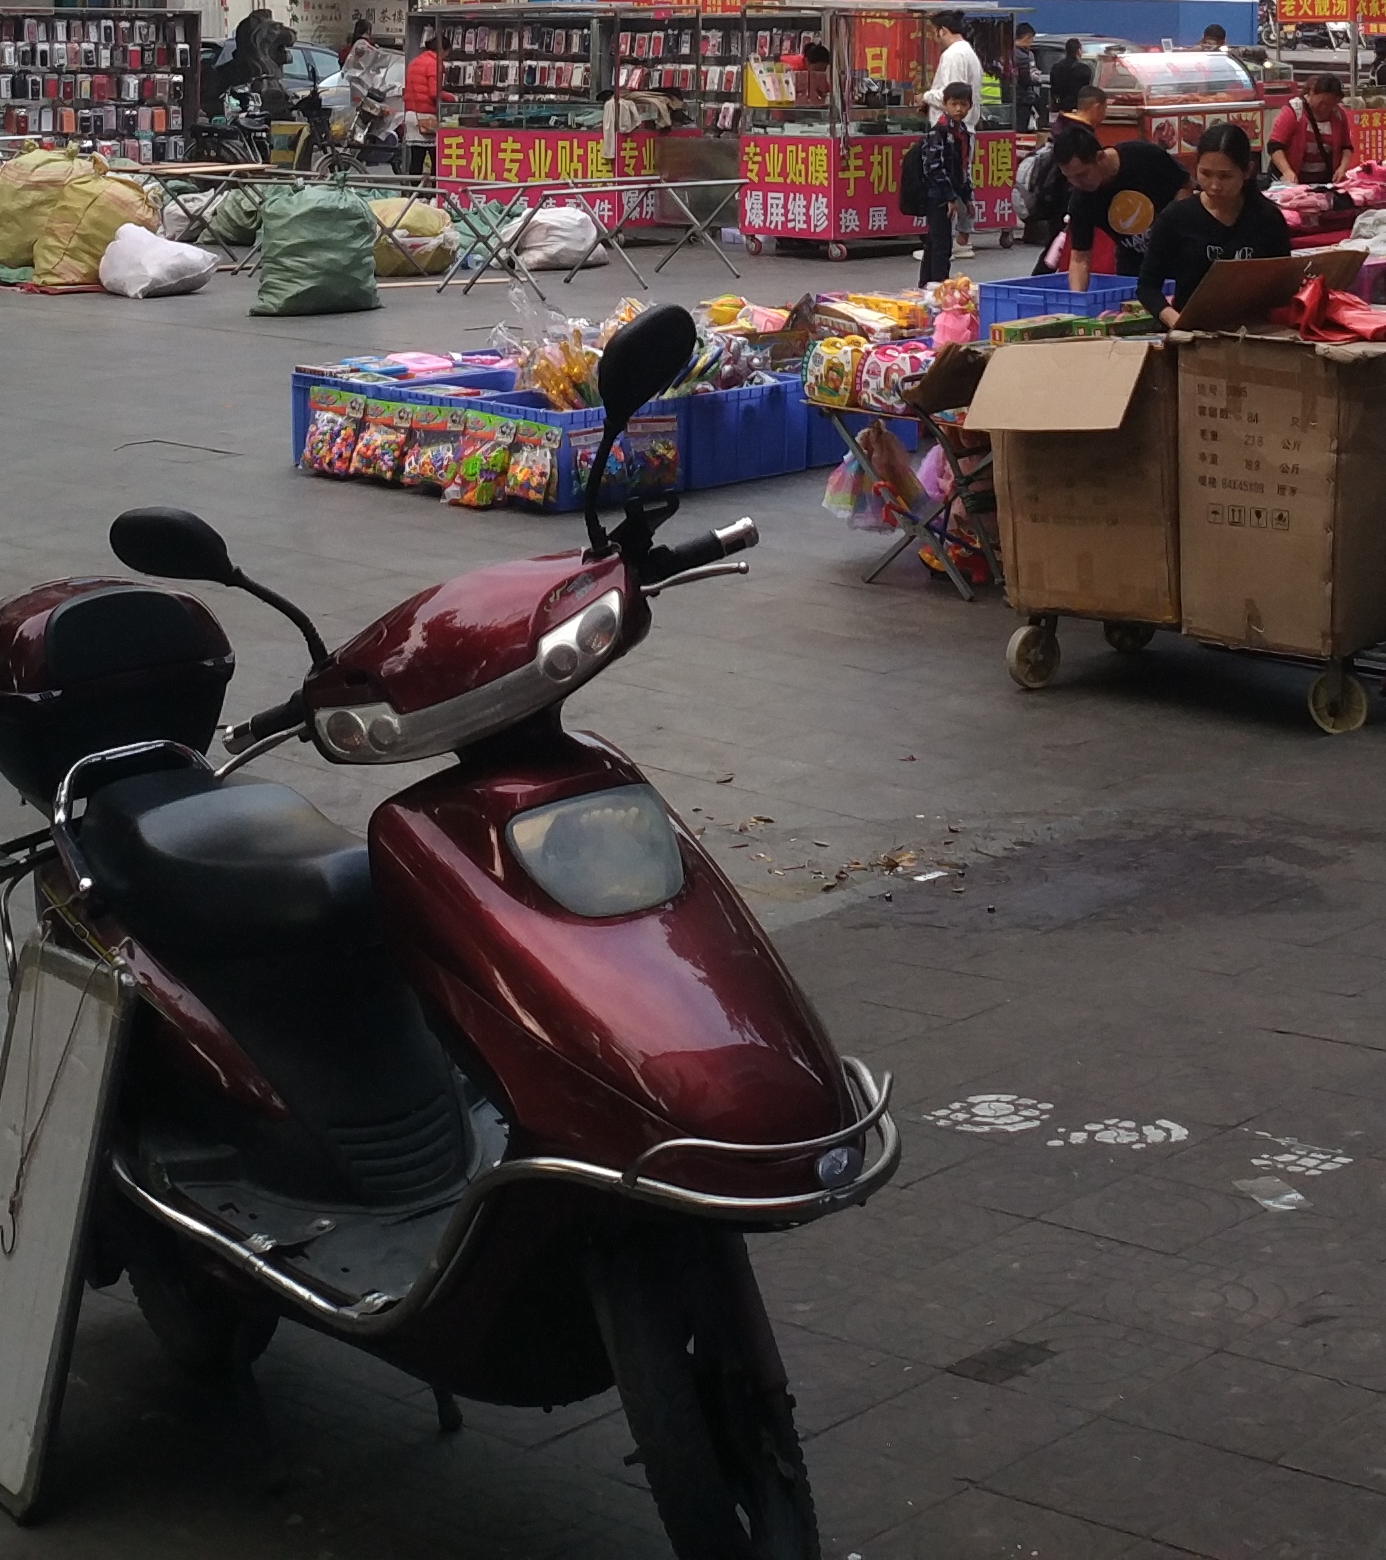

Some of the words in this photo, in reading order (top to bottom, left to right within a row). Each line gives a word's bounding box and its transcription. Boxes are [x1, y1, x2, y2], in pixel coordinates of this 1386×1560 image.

[441, 135, 614, 186] 手机专业贴膜
[743, 141, 830, 188] 专业贴膜
[744, 190, 830, 235] 爆屏维修
[840, 206, 888, 234] 换屏
